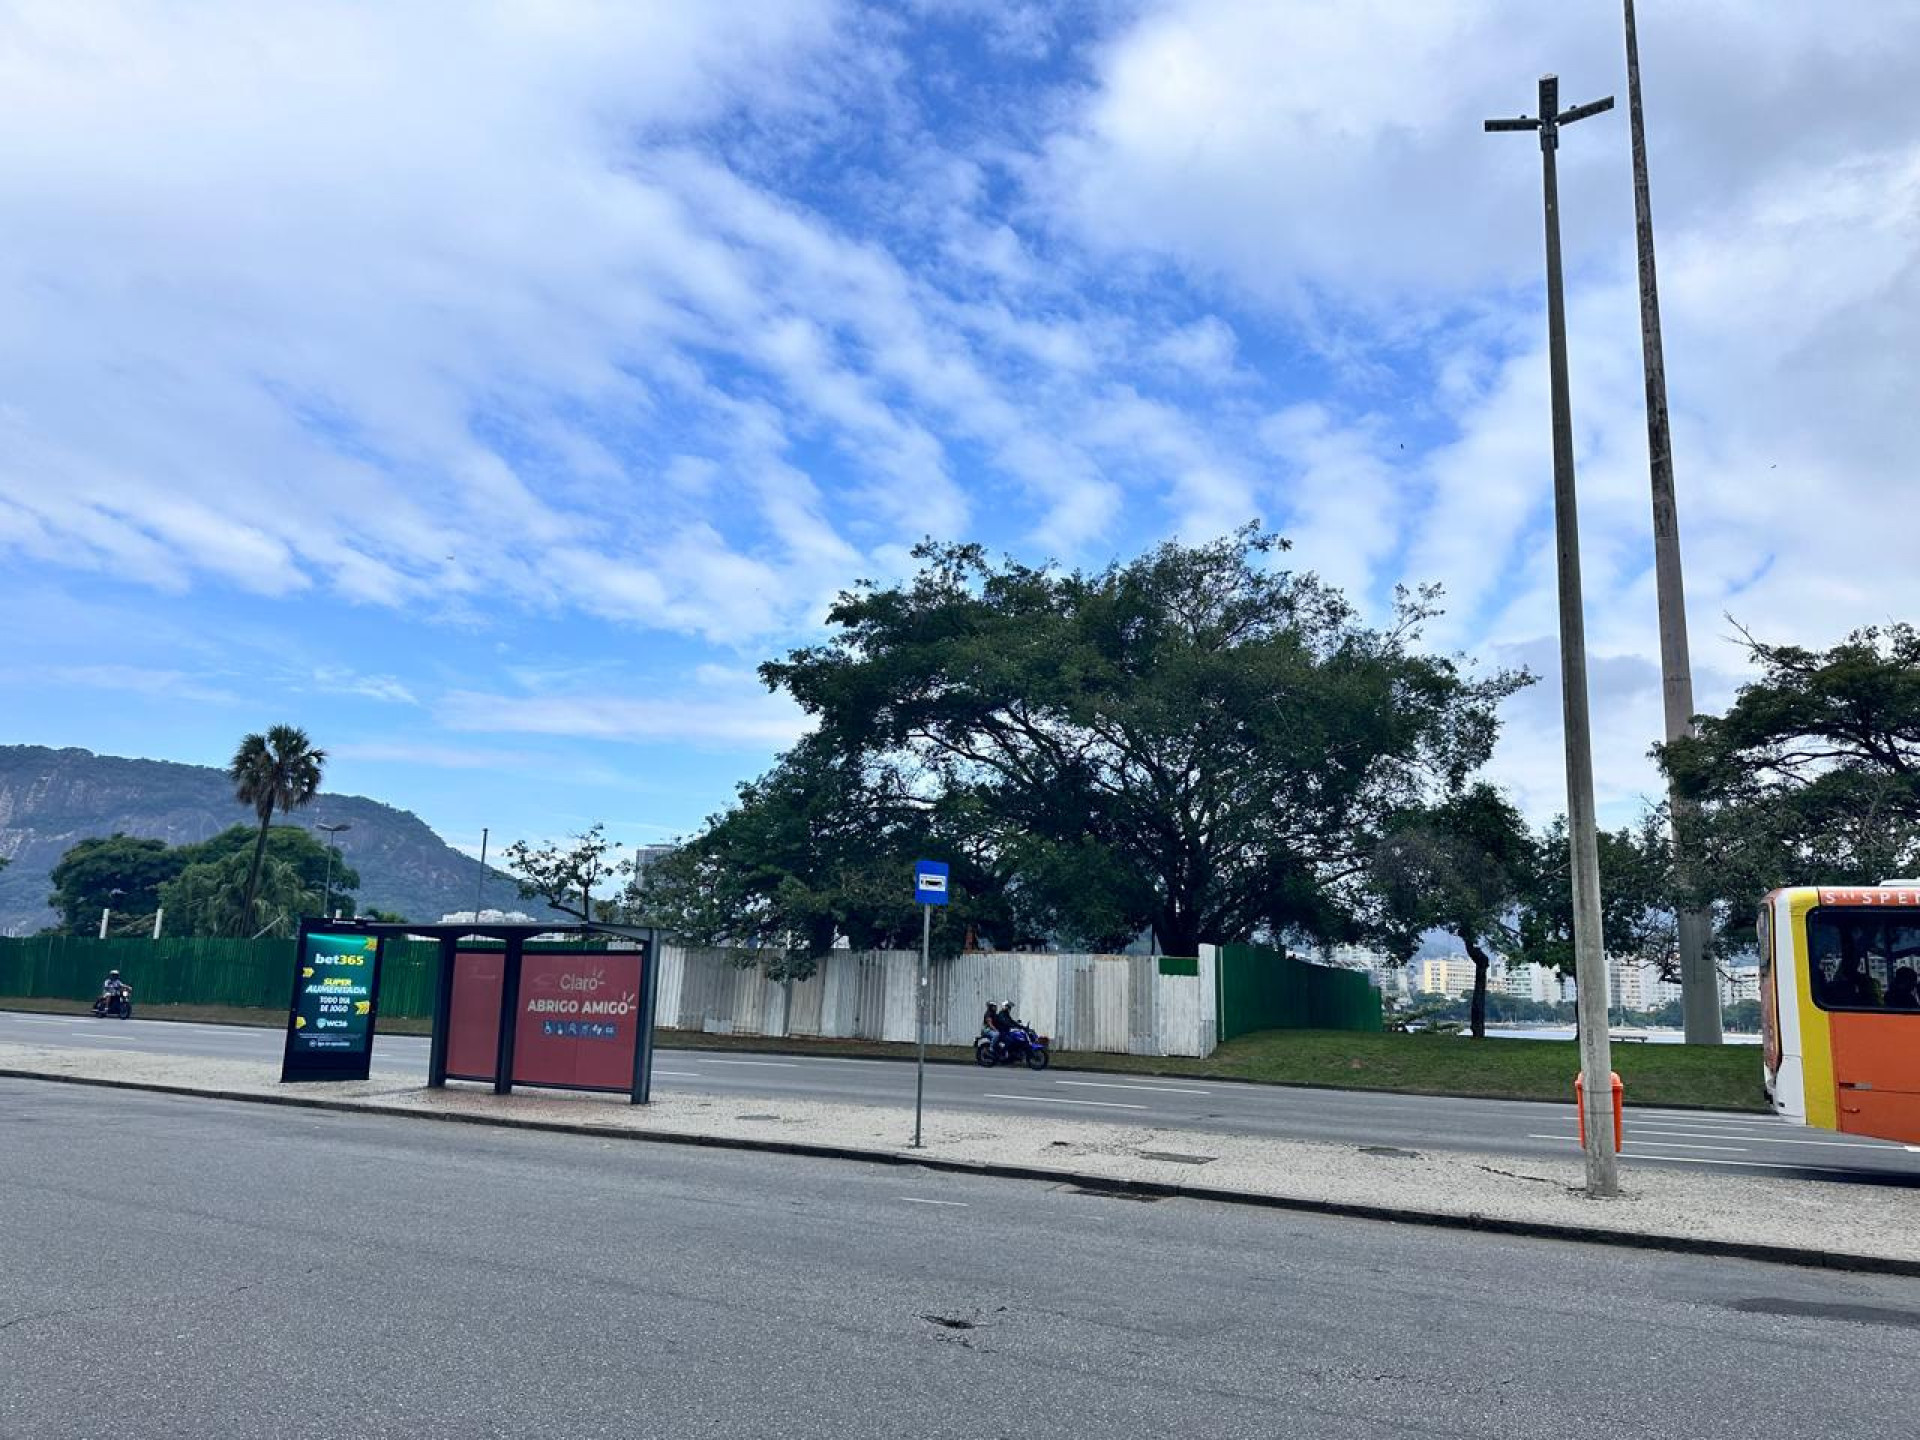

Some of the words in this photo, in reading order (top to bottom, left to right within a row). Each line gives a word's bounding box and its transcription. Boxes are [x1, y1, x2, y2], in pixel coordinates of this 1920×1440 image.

[315, 953, 364, 965] bet365
[323, 977, 352, 987] SUPER
[560, 974, 598, 991] Claro
[305, 984, 367, 994] AUMENTADA
[320, 995, 338, 1004] TODO
[339, 996, 351, 1005] DIA
[320, 1004, 328, 1012] DE
[329, 1004, 349, 1013] JOGO
[527, 998, 579, 1013] ABRIGO
[581, 1001, 628, 1015] AMIGO
